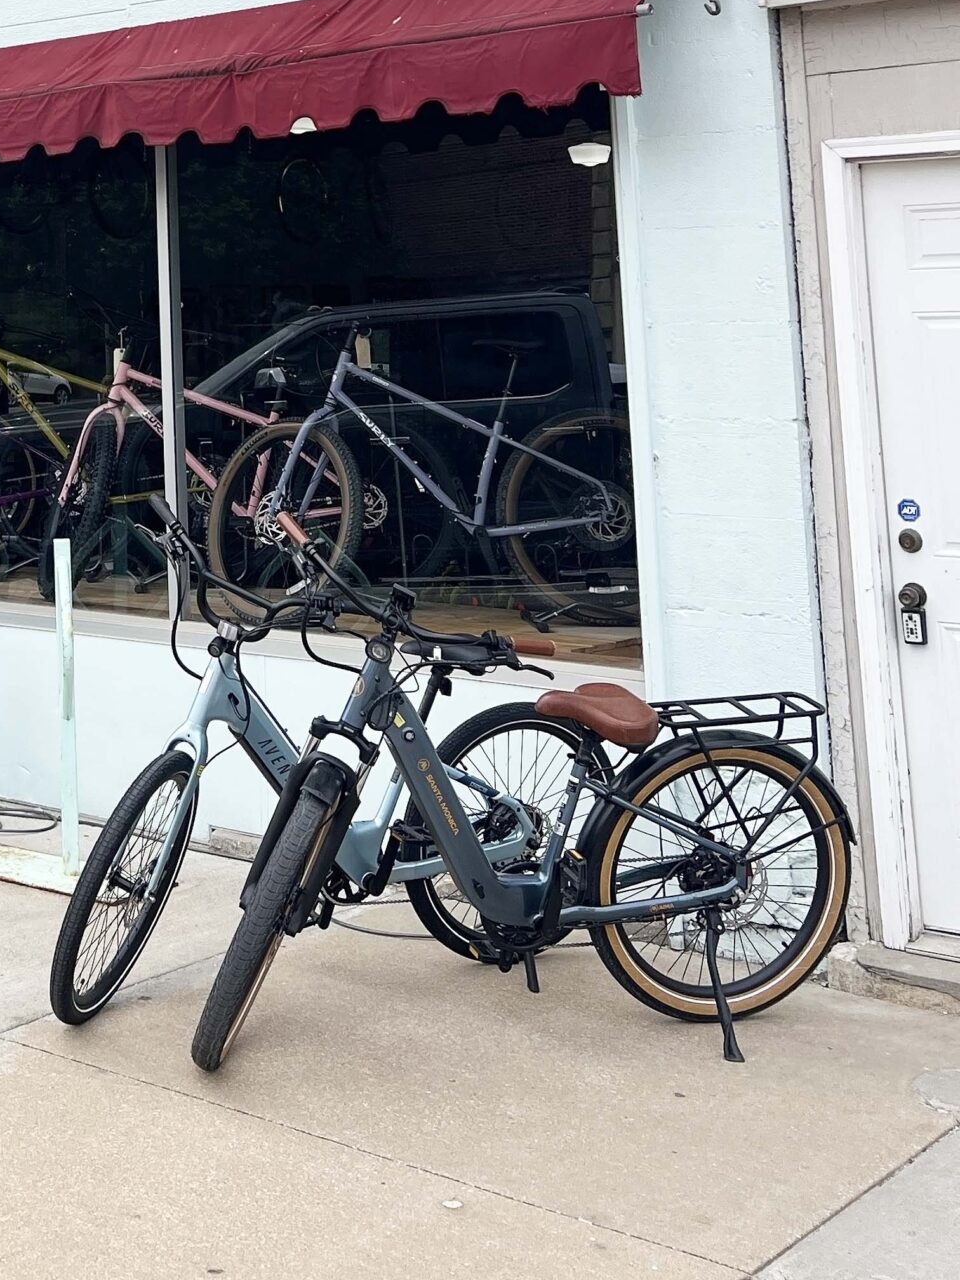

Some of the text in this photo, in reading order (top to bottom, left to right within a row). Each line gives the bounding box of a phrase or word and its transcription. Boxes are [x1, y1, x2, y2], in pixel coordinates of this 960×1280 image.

[142, 409, 165, 437] SUR
[359, 412, 395, 447] SURLY
[901, 506, 917, 515] ADT
[257, 739, 293, 781] AVEN
[426, 774, 460, 836] SANTA MONICA
